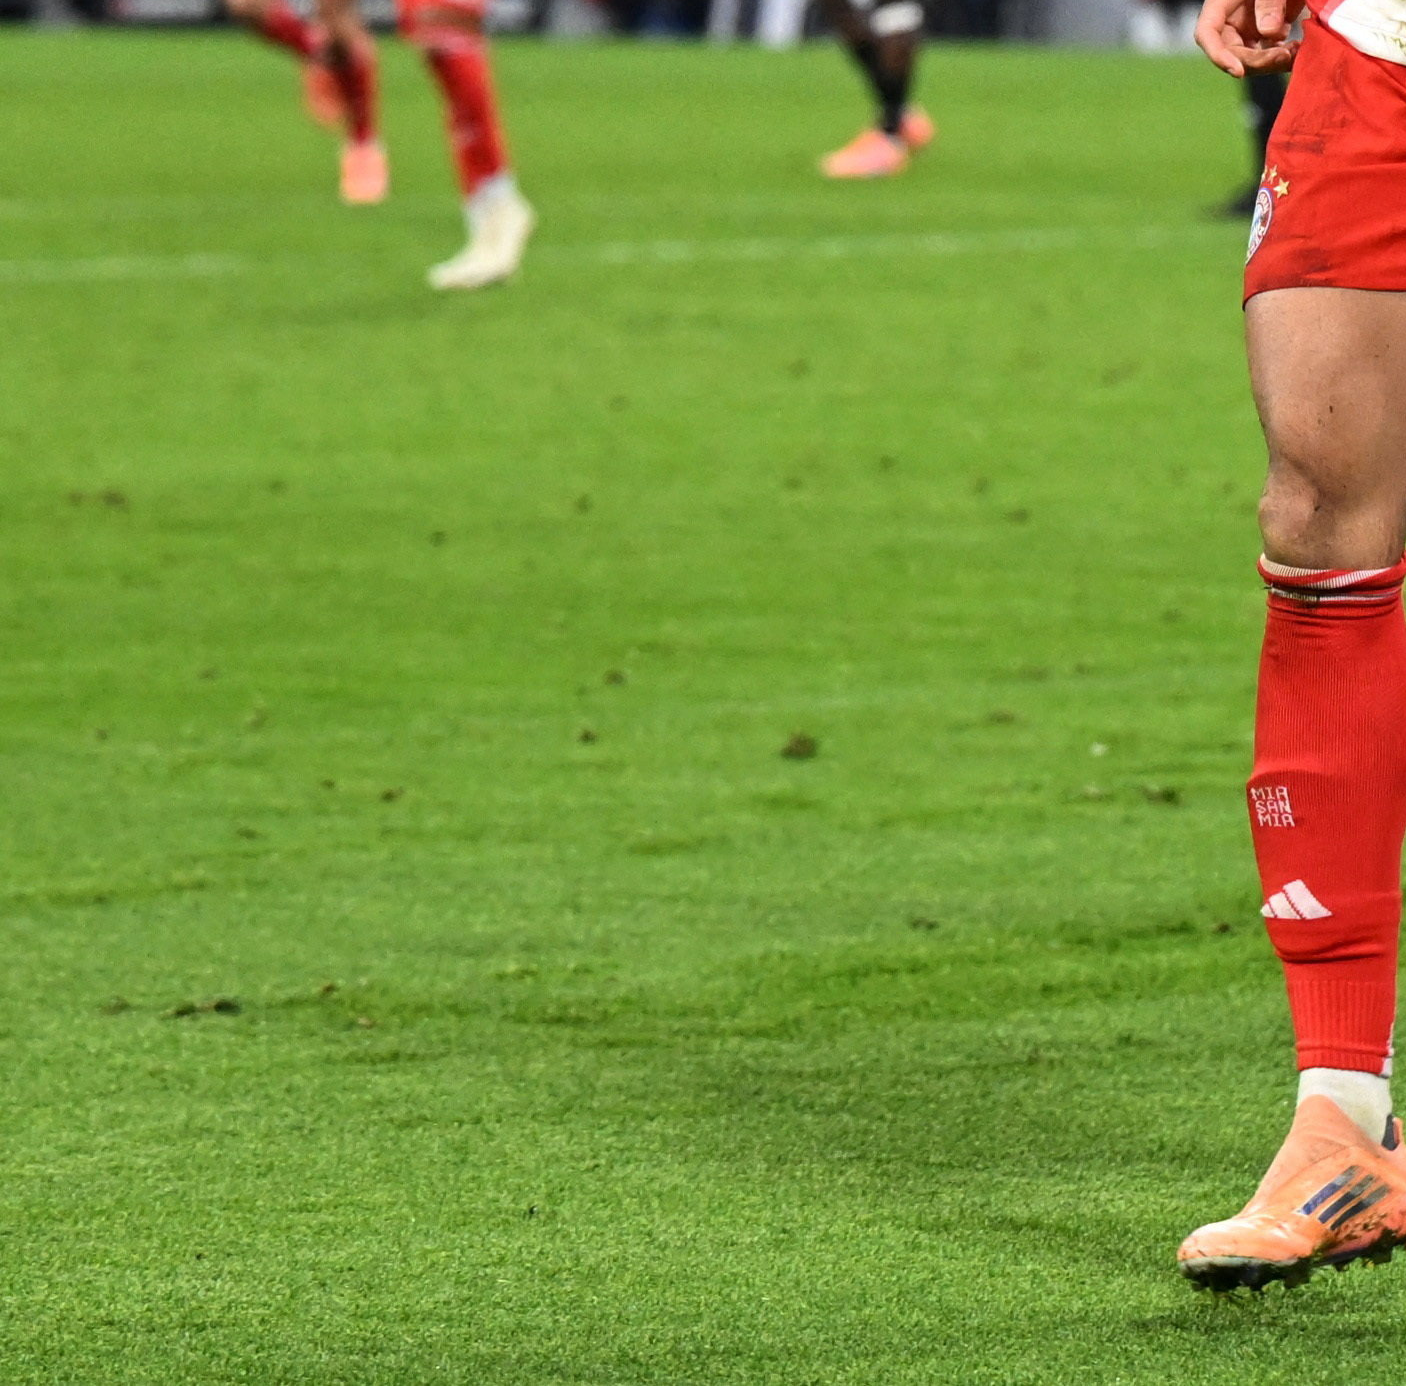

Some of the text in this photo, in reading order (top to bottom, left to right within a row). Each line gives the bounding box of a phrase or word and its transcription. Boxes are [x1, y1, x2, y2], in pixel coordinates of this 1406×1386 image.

[1250, 786, 1289, 801] MIA
[1255, 799, 1293, 814] SAN
[1257, 813, 1295, 827] MIA
